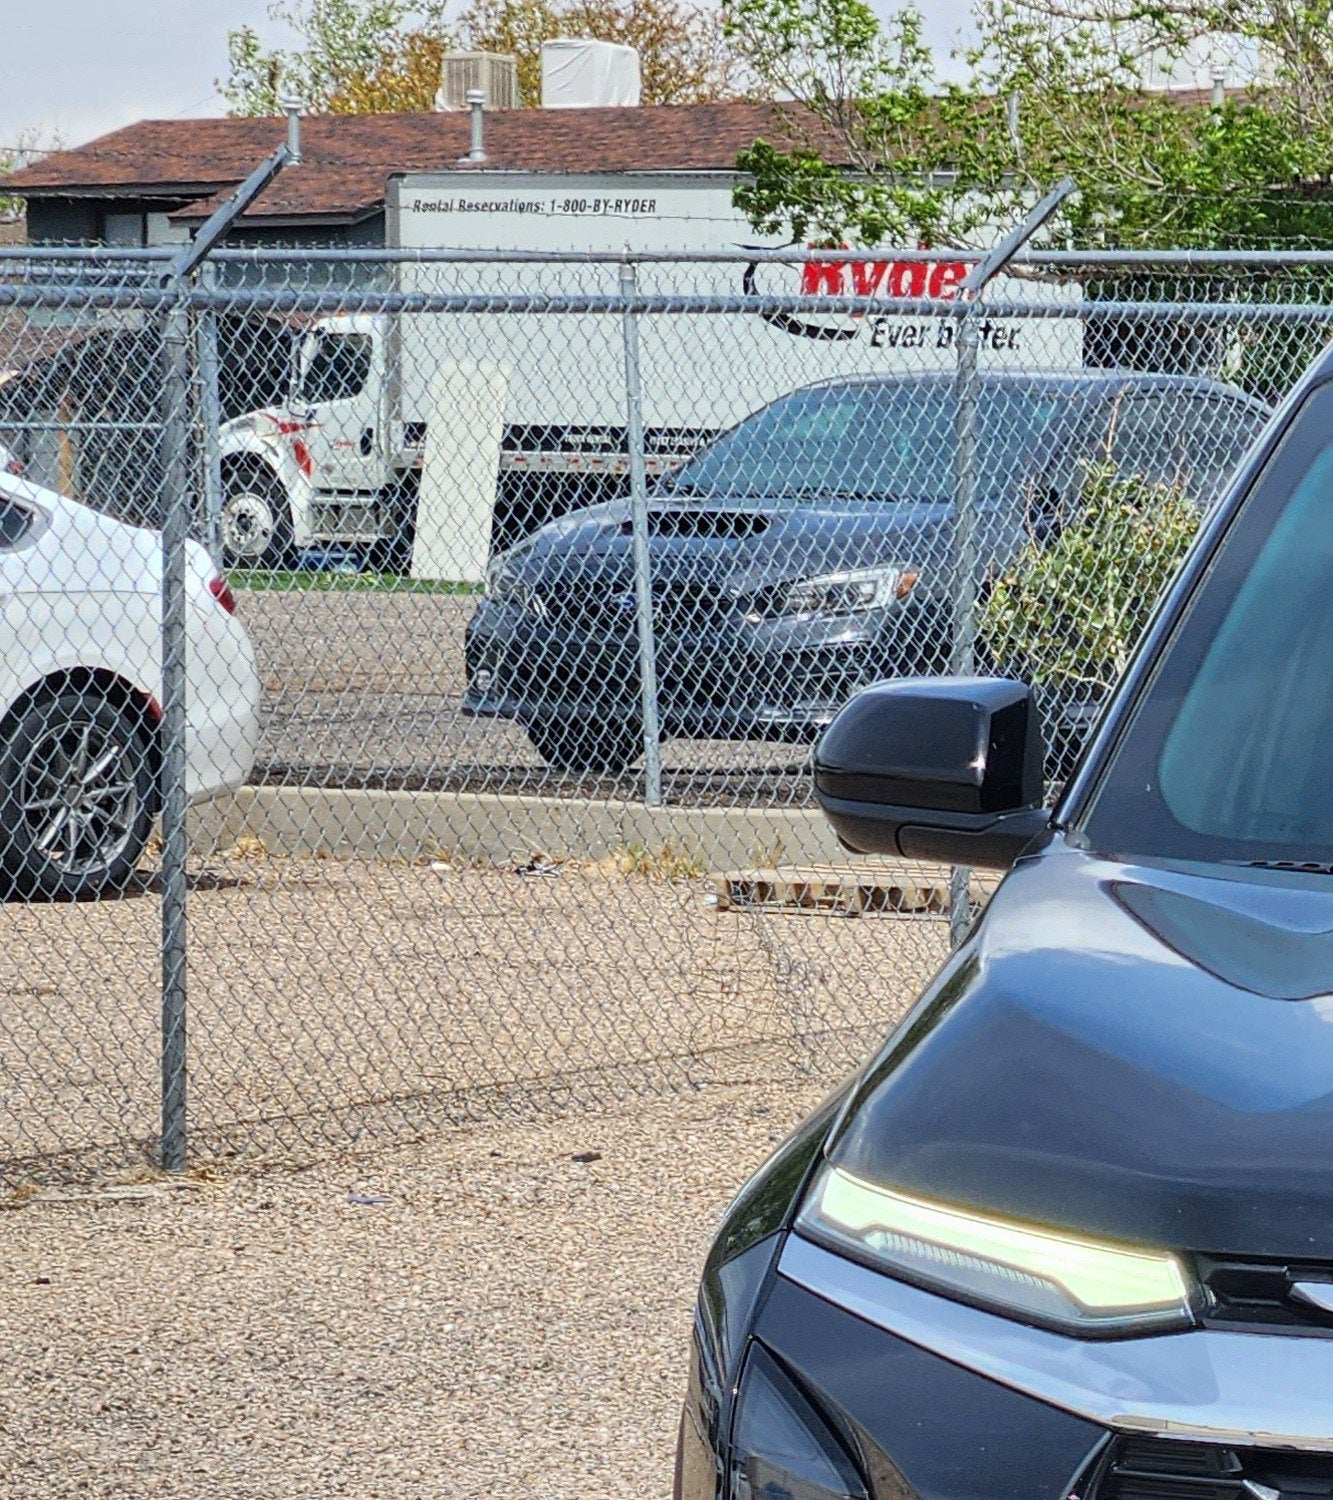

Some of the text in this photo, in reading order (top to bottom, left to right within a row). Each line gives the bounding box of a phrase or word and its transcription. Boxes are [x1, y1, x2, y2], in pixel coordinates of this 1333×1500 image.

[412, 199, 656, 213] Rental Reservations: 1-800-BY-RYDER
[870, 317, 1020, 349] Ever bter.
